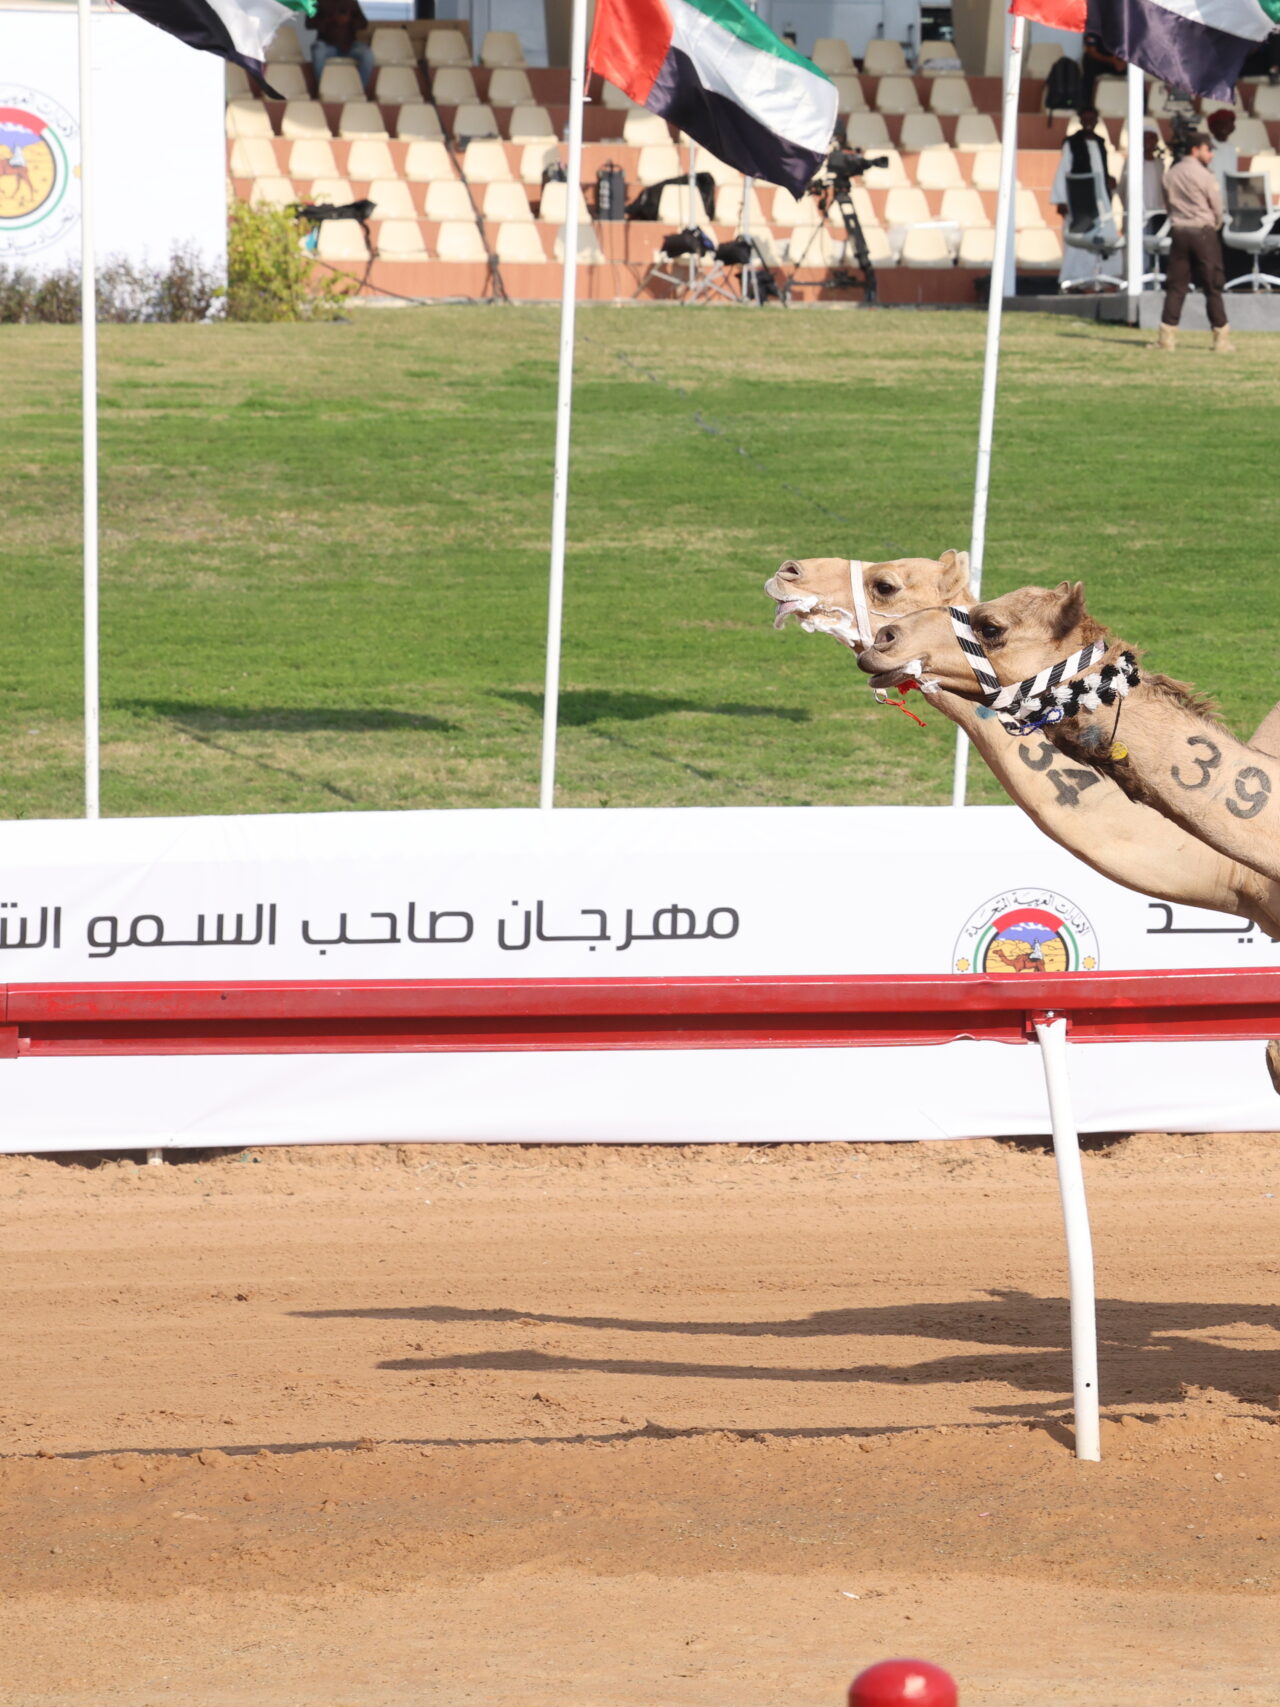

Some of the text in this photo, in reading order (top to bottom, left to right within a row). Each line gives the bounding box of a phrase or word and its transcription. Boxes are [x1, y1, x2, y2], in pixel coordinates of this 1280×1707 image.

[1170, 735, 1272, 820] 39
[87, 903, 276, 958] السمو
[302, 901, 474, 955] صاحب
[497, 899, 740, 952] مهرجان
